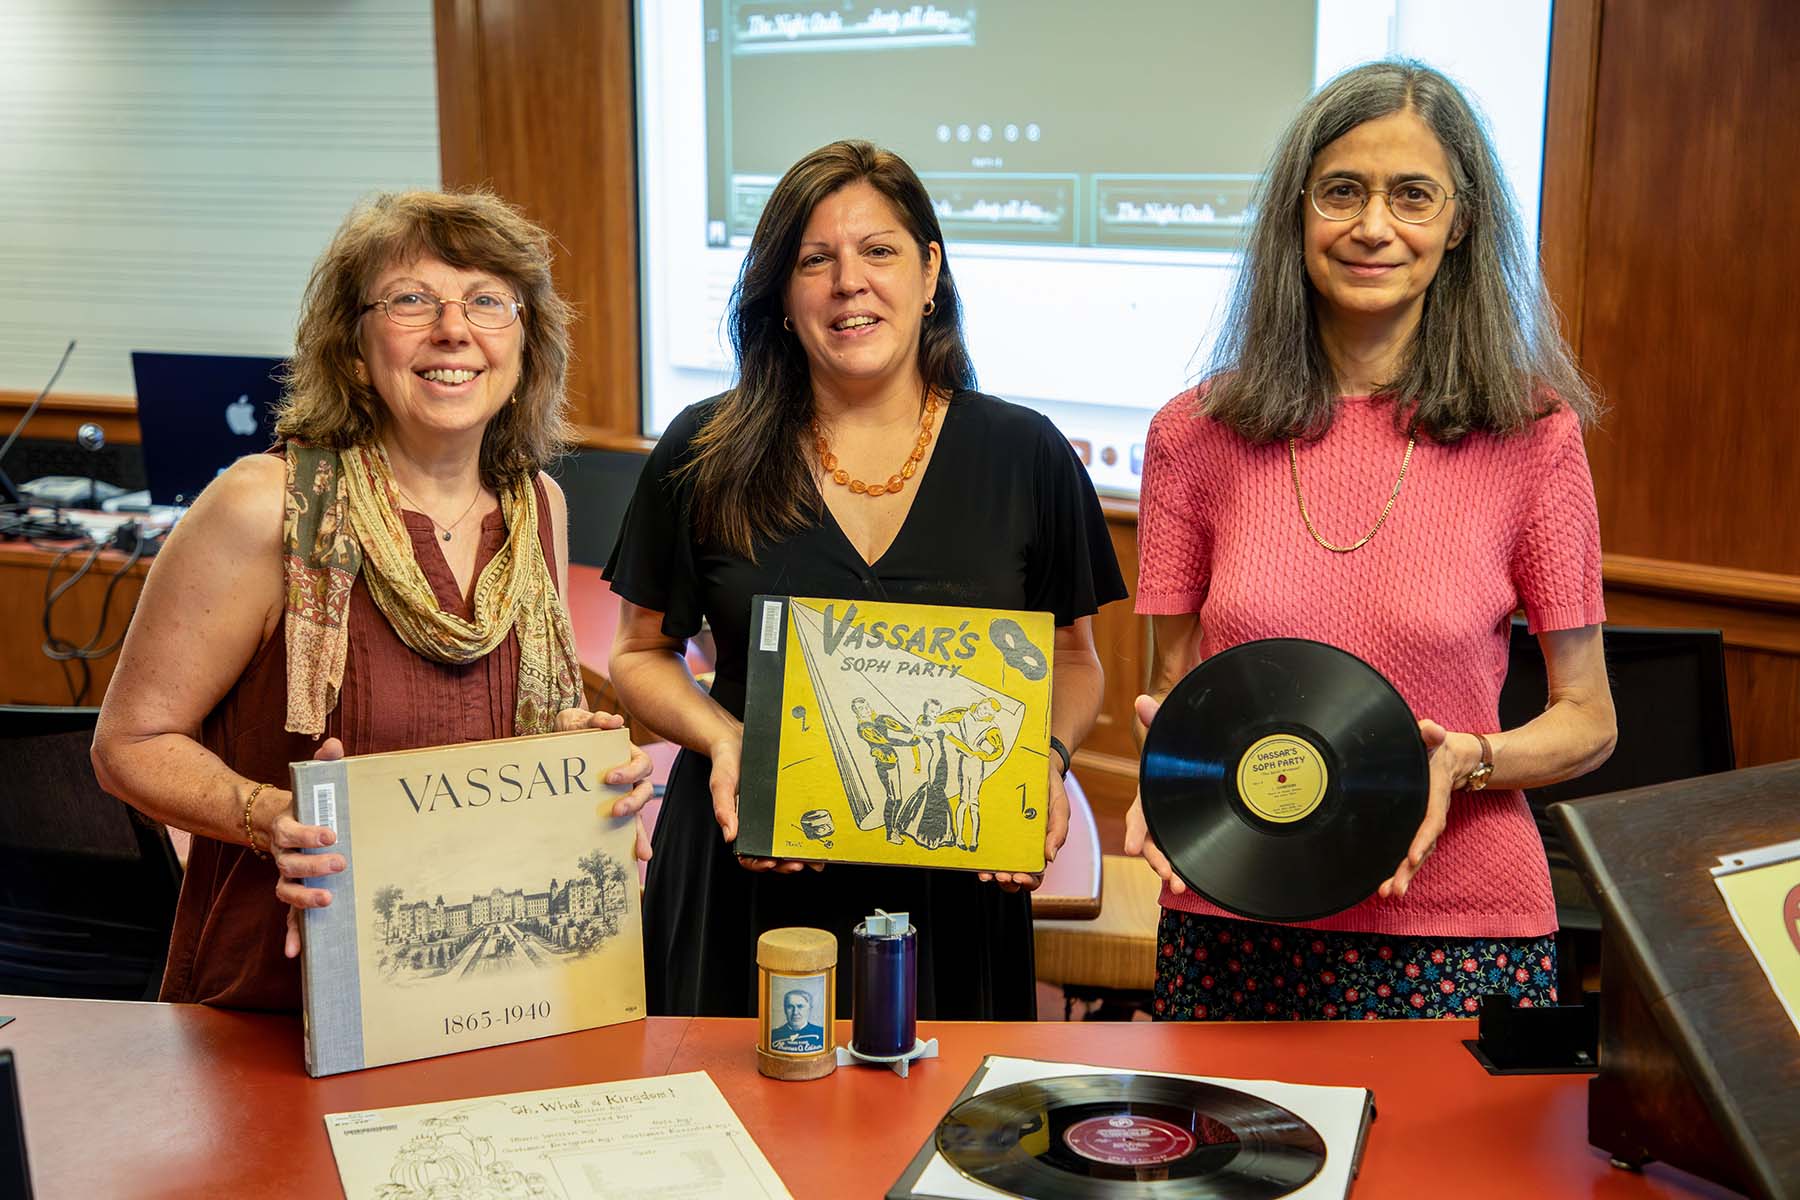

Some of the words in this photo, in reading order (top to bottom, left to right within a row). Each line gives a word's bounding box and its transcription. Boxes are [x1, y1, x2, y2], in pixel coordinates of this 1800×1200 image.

[823, 603, 981, 661] VASSAR'S
[840, 656, 889, 673] SOPH
[896, 661, 963, 678] PARTY
[1252, 763, 1276, 772] SOPH
[1277, 756, 1305, 768] PARTY
[1257, 748, 1298, 761] VASSAR'S
[398, 756, 592, 814] VASSAR
[443, 1000, 551, 1035] 1865-1940
